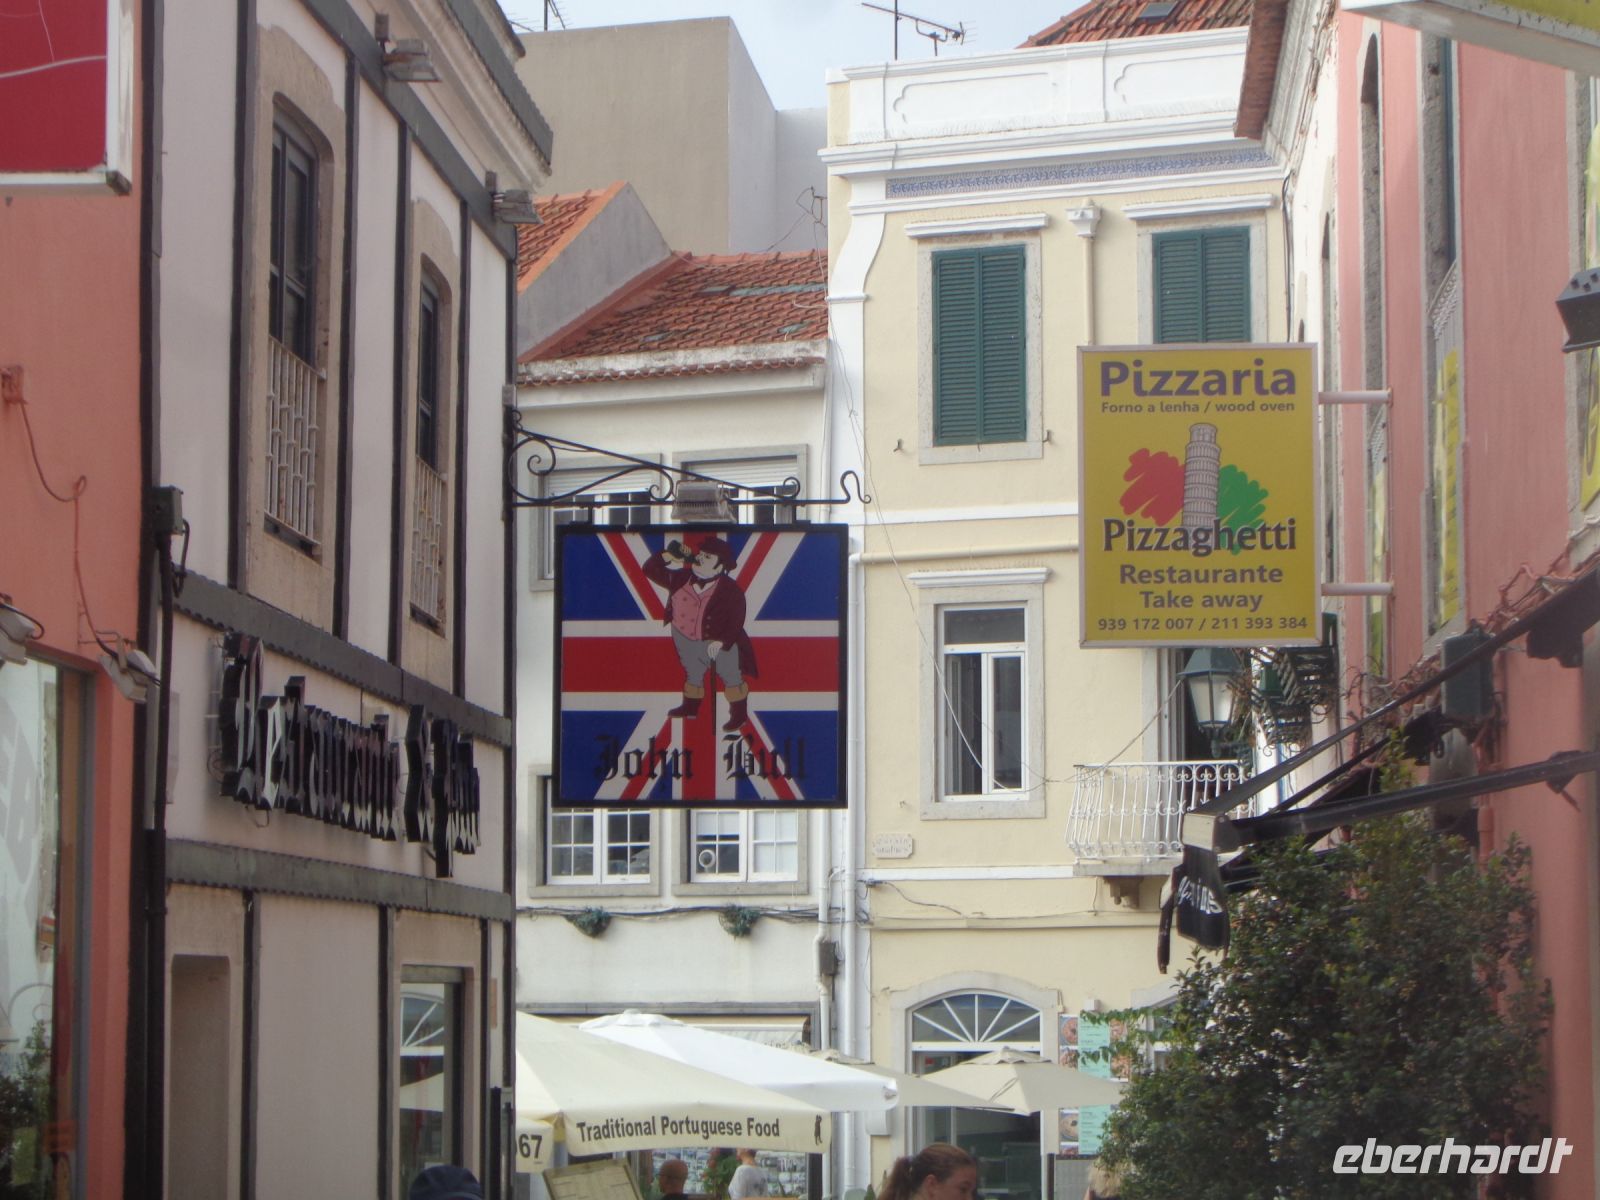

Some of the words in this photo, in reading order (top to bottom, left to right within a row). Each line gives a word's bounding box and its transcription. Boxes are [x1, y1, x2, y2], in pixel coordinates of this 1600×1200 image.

[1100, 358, 1296, 397] Pizzaria
[1101, 402, 1143, 413] Forno
[1147, 404, 1156, 412] a
[1160, 401, 1200, 412] lenha
[1215, 401, 1255, 412] wood
[1259, 402, 1295, 412] oven
[1103, 518, 1297, 557] Pizzaghetti
[1119, 564, 1283, 584] Restaurante
[1140, 591, 1194, 608] Take
[1201, 594, 1263, 612] away
[1098, 619, 1126, 631] 939
[1132, 618, 1160, 630] 172
[1165, 618, 1193, 630] 007
[1211, 617, 1238, 629] 211
[1245, 617, 1273, 629] 393
[1279, 616, 1308, 628] 384
[594, 734, 694, 781] John
[722, 734, 805, 780] Bull
[576, 1116, 656, 1142] Traditional
[661, 1115, 742, 1140] Portuguese
[747, 1118, 780, 1137] Food
[518, 1133, 543, 1159] 67
